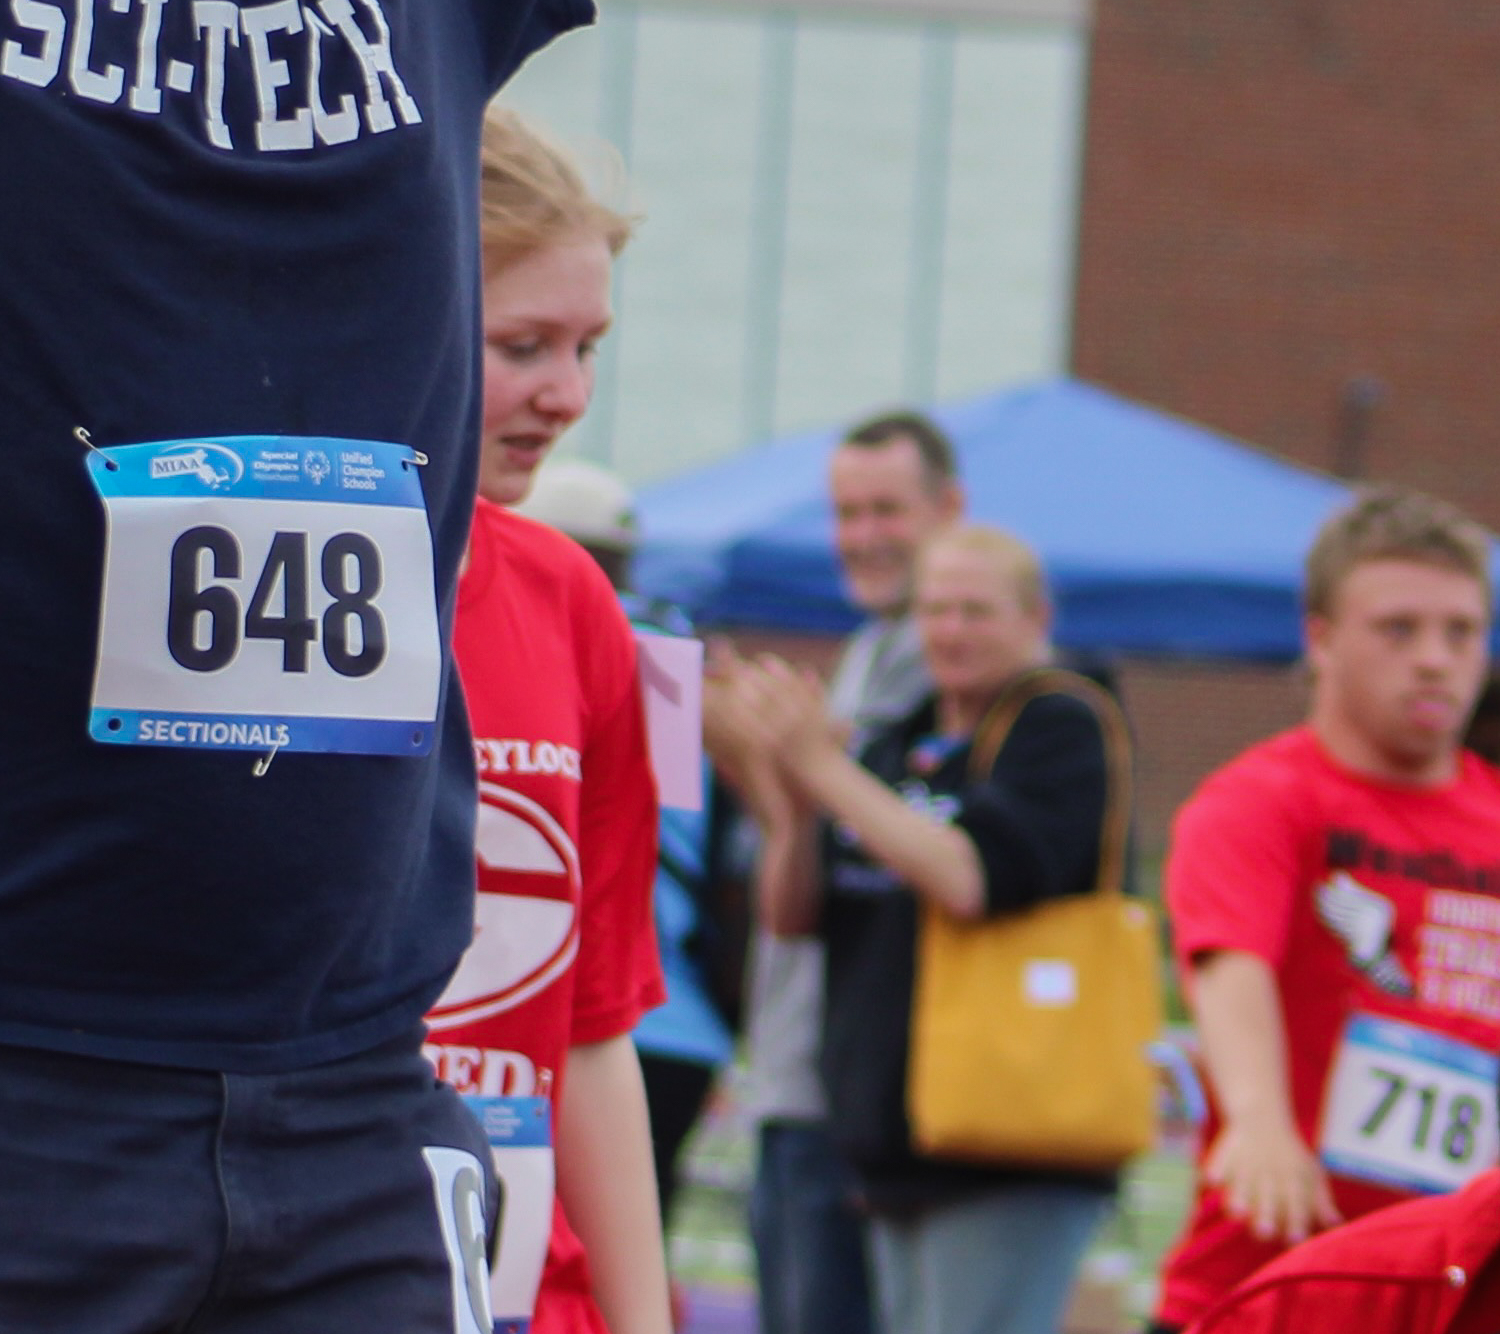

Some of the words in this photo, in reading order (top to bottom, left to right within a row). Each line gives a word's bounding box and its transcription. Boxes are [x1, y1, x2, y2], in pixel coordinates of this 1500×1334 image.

[153, 457, 202, 476] MIAA
[166, 524, 389, 679] 648
[138, 718, 291, 747] SECTIONALS
[1360, 1067, 1483, 1164] 718
